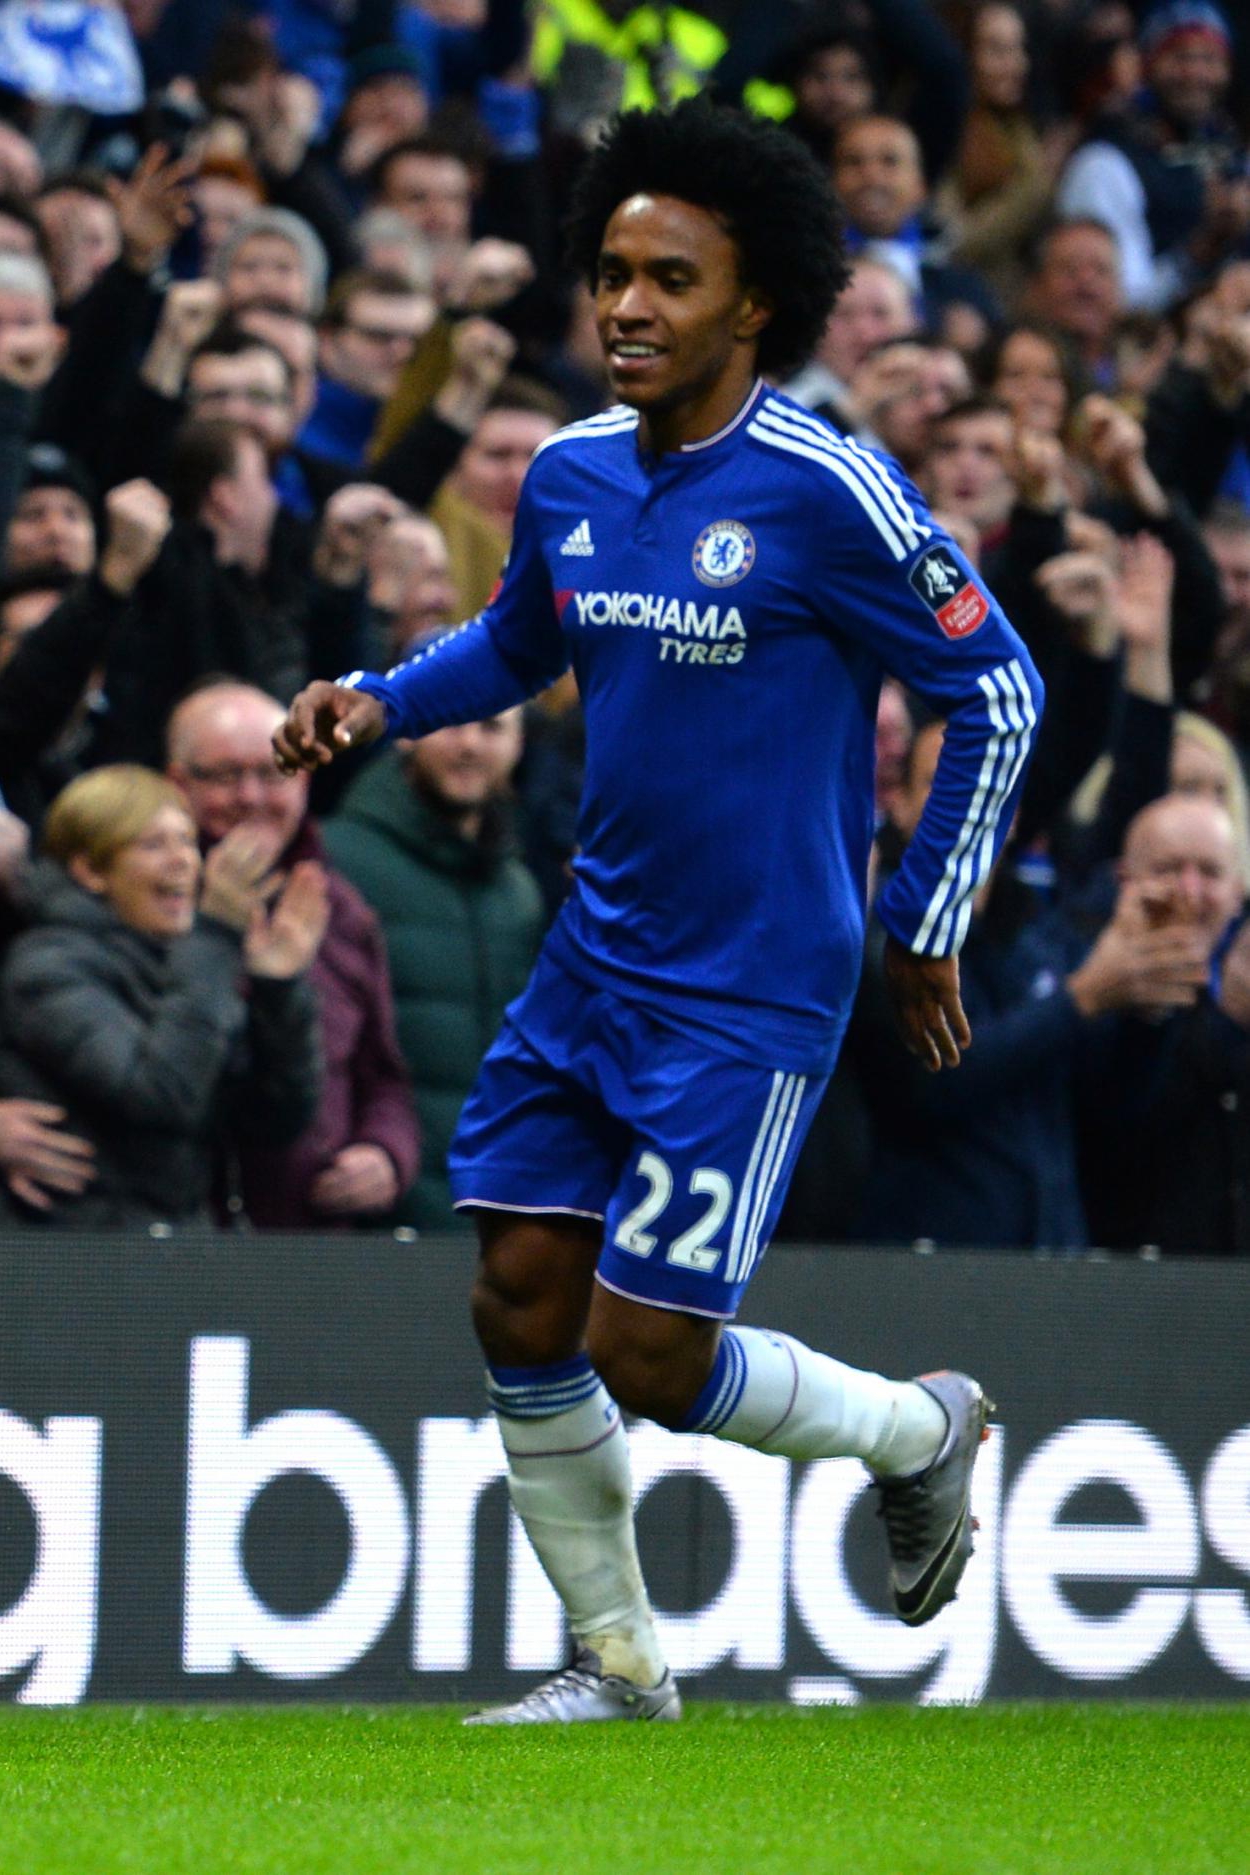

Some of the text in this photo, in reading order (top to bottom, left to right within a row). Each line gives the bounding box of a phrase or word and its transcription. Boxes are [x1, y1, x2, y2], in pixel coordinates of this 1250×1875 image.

[574, 591, 747, 640] YOKOHAMA
[659, 637, 747, 665] TYRES
[614, 1150, 724, 1274] 22
